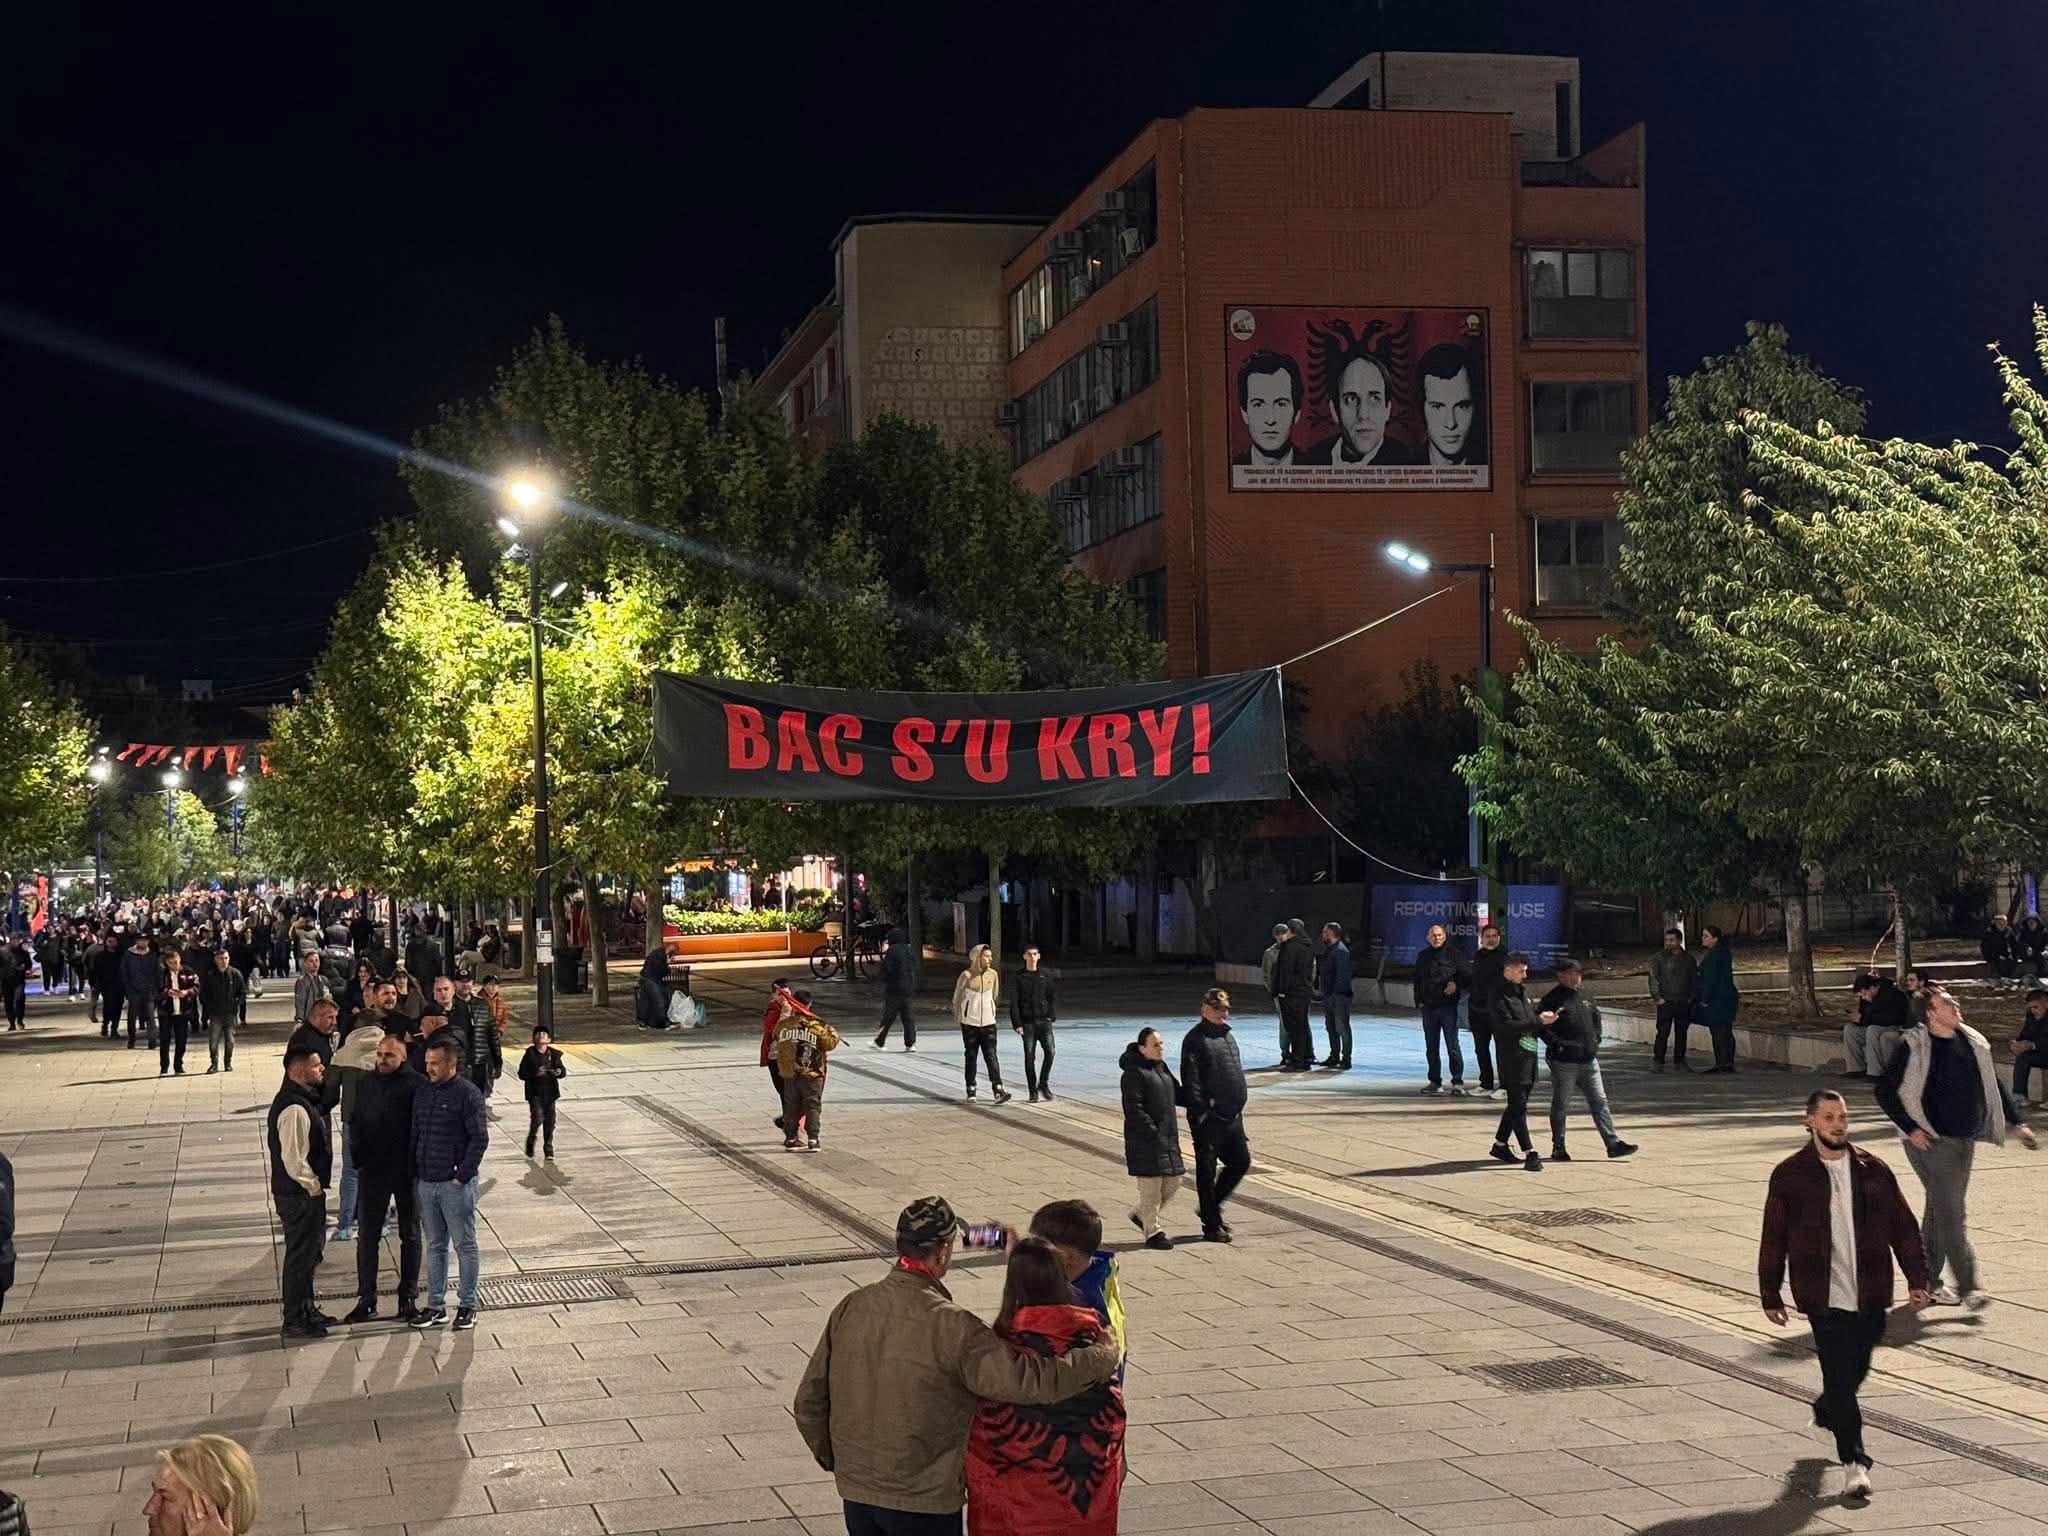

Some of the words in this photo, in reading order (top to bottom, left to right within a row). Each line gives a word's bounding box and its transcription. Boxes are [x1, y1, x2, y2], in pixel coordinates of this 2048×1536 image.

[724, 703, 864, 776] BAC
[892, 717, 1011, 784] S'U
[1037, 703, 1212, 781] KRY!
[1394, 902, 1479, 917] REPORTING
[1507, 903, 1545, 918] USE
[1441, 924, 1480, 936] MUSEU
